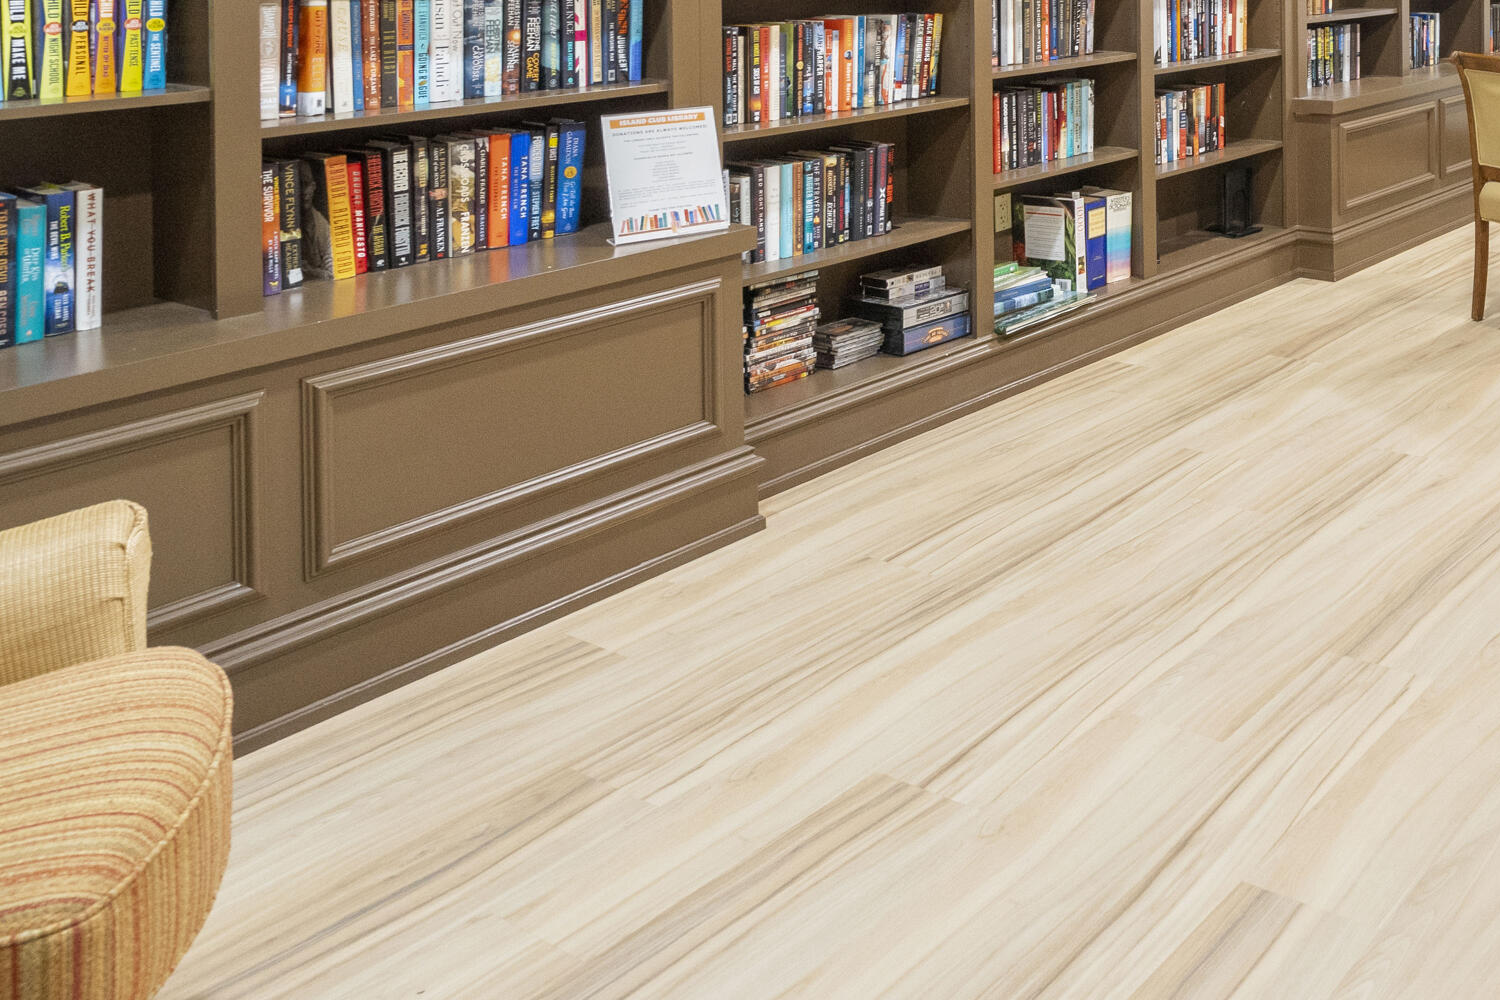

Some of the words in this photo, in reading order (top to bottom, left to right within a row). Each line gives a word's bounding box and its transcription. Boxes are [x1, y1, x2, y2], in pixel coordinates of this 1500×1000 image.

[48, 37, 59, 58] NIGHT
[129, 34, 138, 48] PAST
[527, 17, 535, 51] FEEHAN
[12, 39, 25, 63] MAKE
[75, 35, 86, 75] PERSONAL
[129, 50, 138, 66] TENSE
[150, 43, 161, 72] SENTINEL
[418, 53, 427, 73] GOING
[617, 35, 628, 72] JUDGMENT
[924, 36, 932, 62] HIGGINS
[12, 66, 26, 80] ME
[48, 59, 59, 85] SCHOOL
[263, 169, 273, 184] THE
[284, 163, 295, 195] VINCE
[60, 205, 70, 231] Robert
[87, 193, 96, 223] WHAT
[264, 186, 274, 222] SURVIVOR
[285, 197, 295, 228] FLYNN
[394, 193, 410, 227] FREDERICK
[87, 230, 96, 251] YOU
[355, 210, 365, 257] MANIFESTO
[395, 226, 410, 256] FORSYTH
[461, 212, 470, 253] FRANZEN
[87, 257, 95, 293] BREAK
